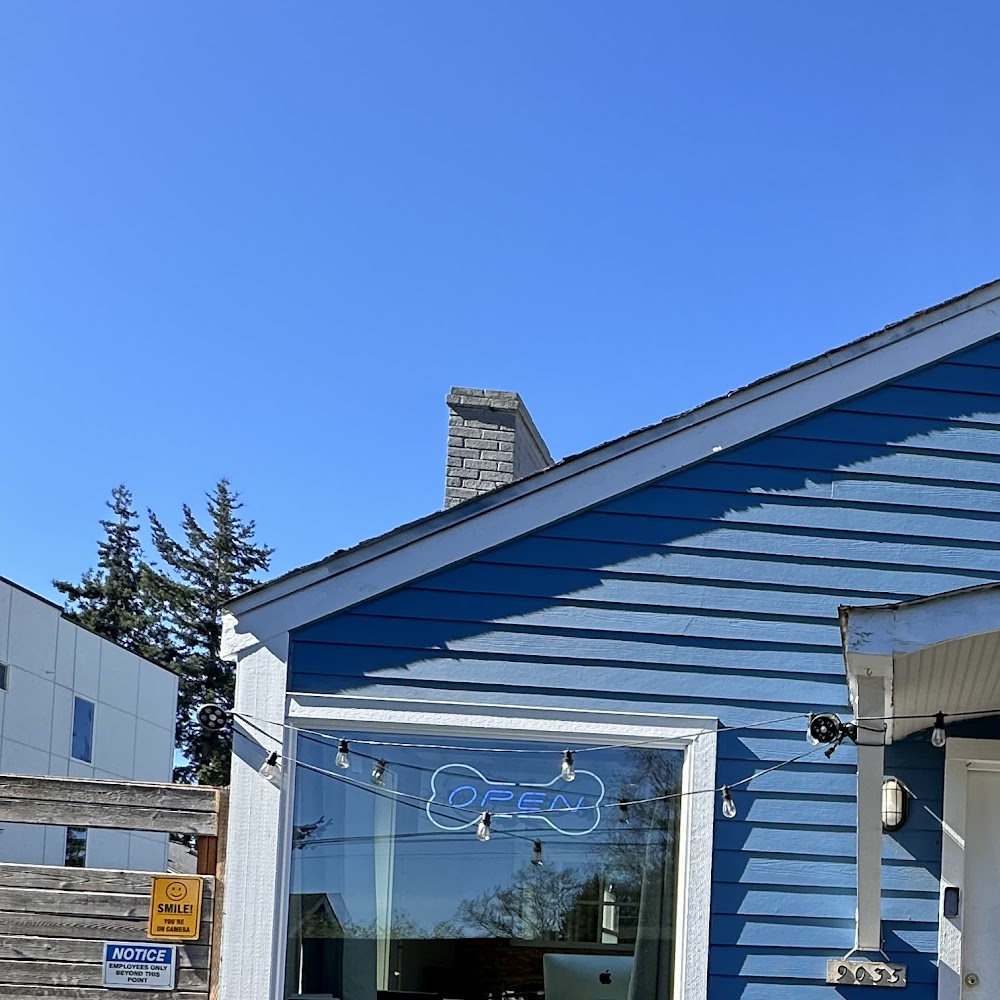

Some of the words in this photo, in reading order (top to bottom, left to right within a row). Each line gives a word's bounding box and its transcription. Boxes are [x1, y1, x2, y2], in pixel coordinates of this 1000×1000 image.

[448, 785, 585, 813] OPEN
[157, 903, 193, 914] SMILE!
[112, 947, 167, 962] NOTICE
[836, 965, 903, 984] 9035
